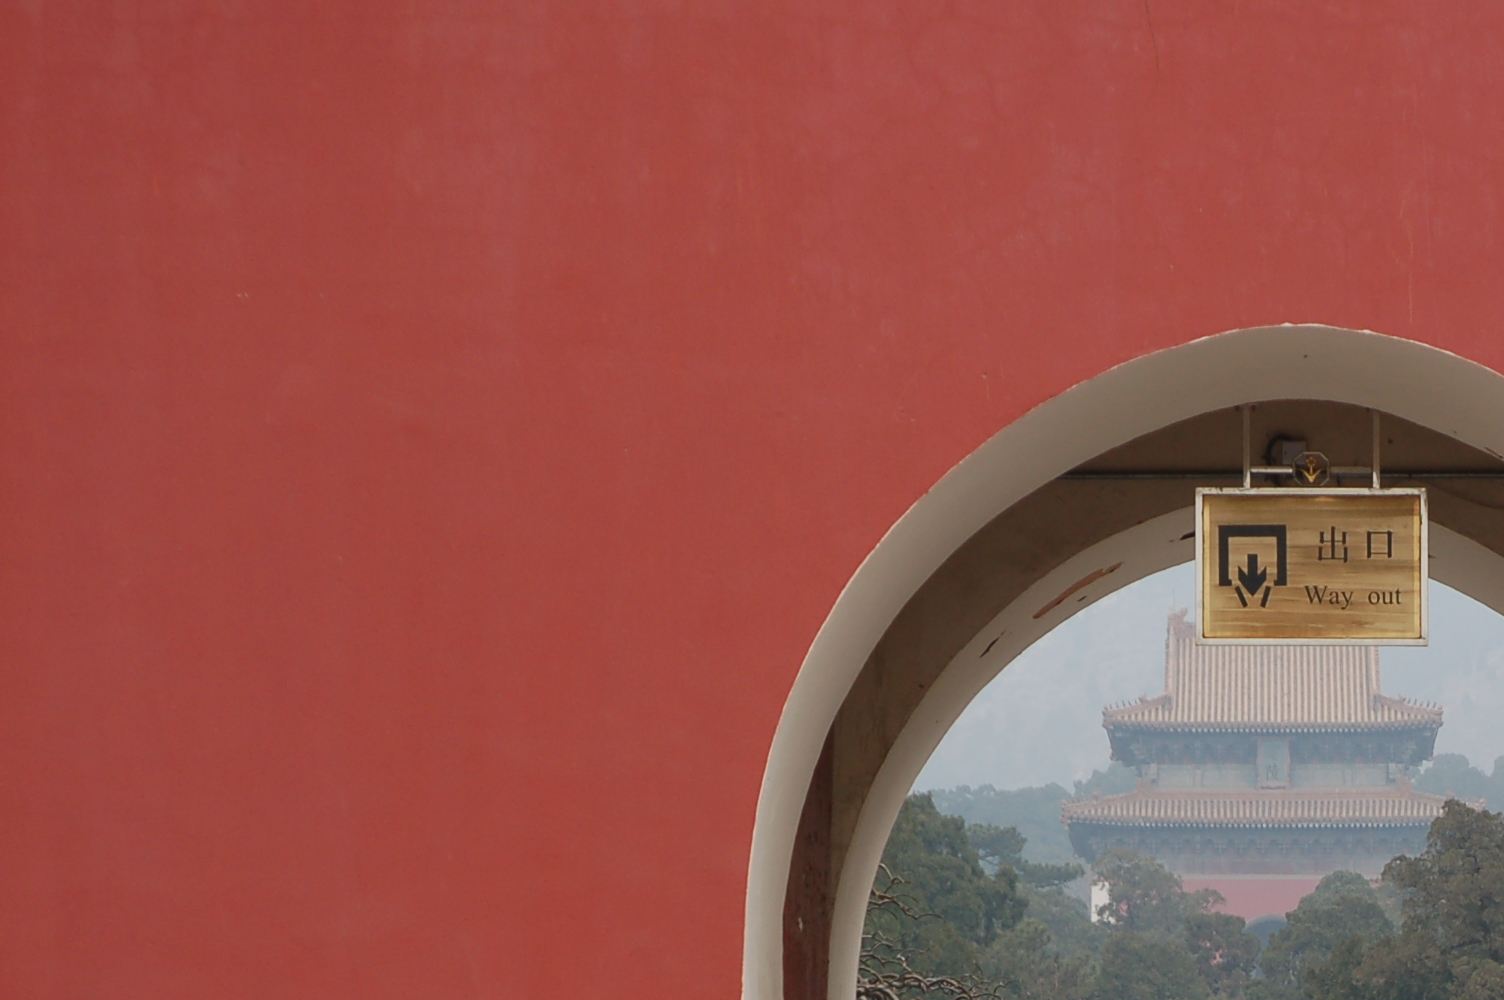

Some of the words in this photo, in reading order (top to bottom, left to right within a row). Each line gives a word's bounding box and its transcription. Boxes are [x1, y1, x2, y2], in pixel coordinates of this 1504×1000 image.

[1317, 525, 1393, 564] 出口
[1304, 584, 1354, 610] Way
[1367, 588, 1402, 606] out
